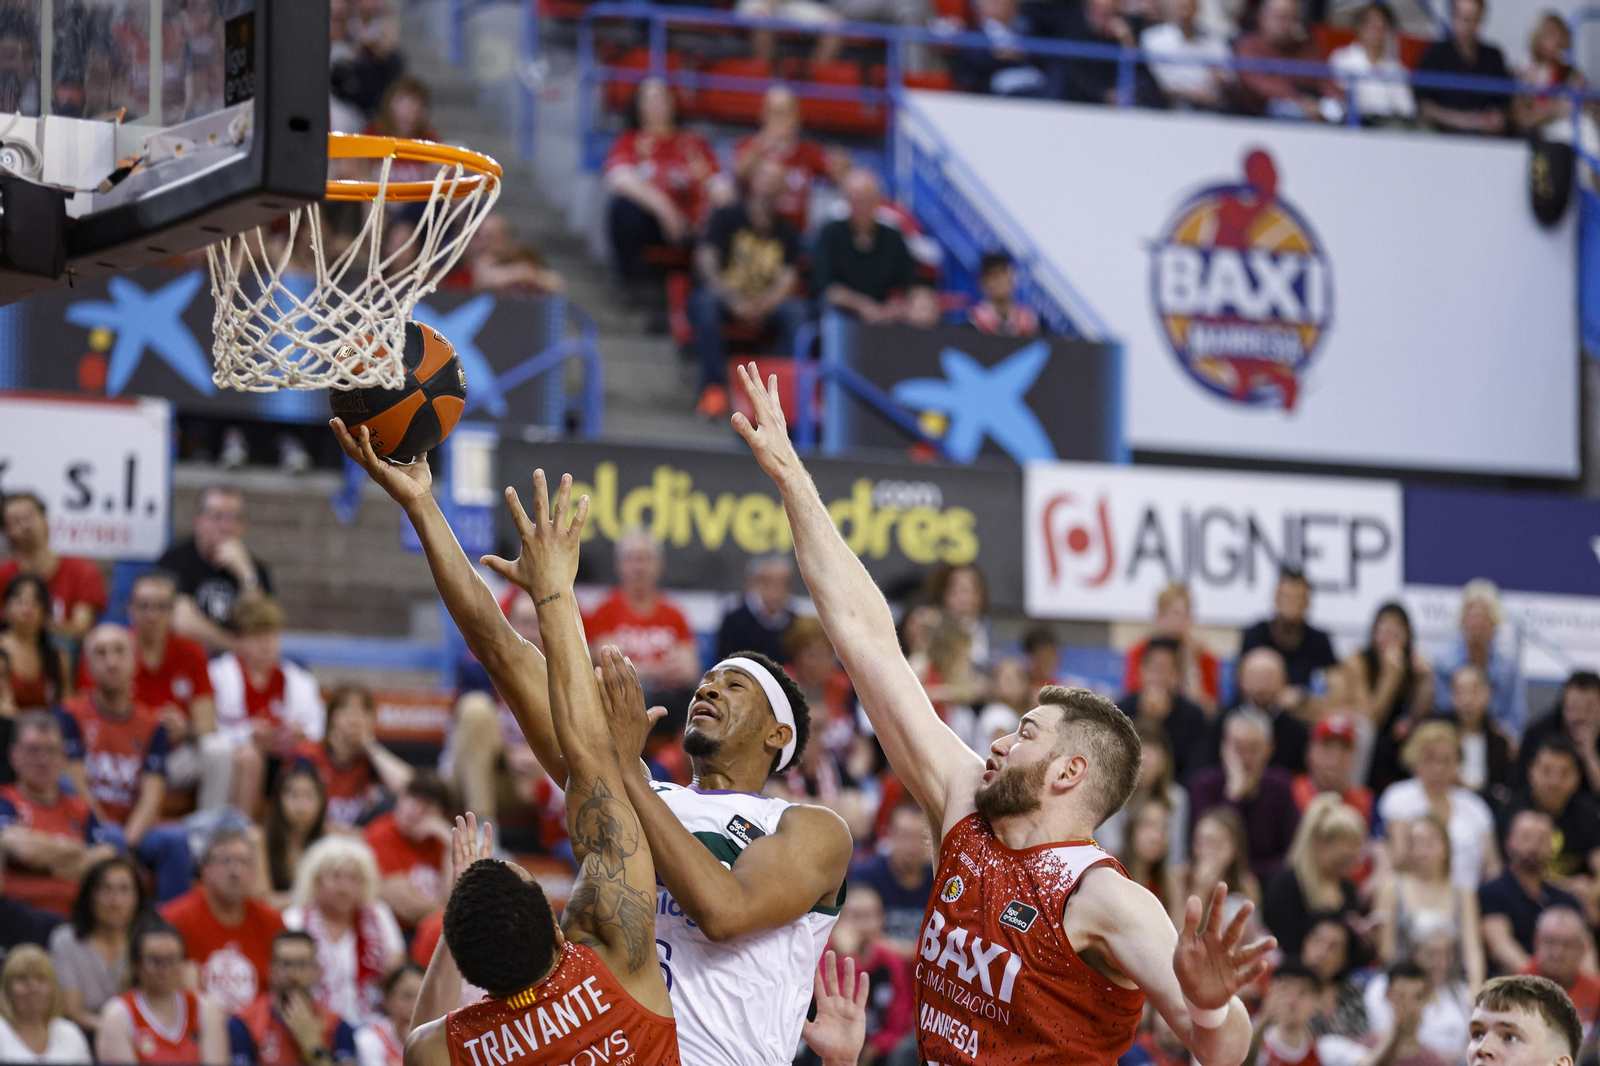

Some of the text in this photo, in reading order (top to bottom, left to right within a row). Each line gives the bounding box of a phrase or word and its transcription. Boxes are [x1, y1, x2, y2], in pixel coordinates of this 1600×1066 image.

[1161, 249, 1325, 323] BAXI
[552, 461, 980, 565] eldivedres
[1124, 503, 1394, 594] AIGNEP
[729, 825, 753, 844] endes
[732, 819, 747, 832] liga
[1002, 913, 1028, 930] endesa
[1006, 906, 1019, 917] liga
[919, 907, 1023, 1004] BAXI
[463, 974, 612, 1066] TRAVANTE
[915, 962, 1011, 1026] CIMATIZACIÓN
